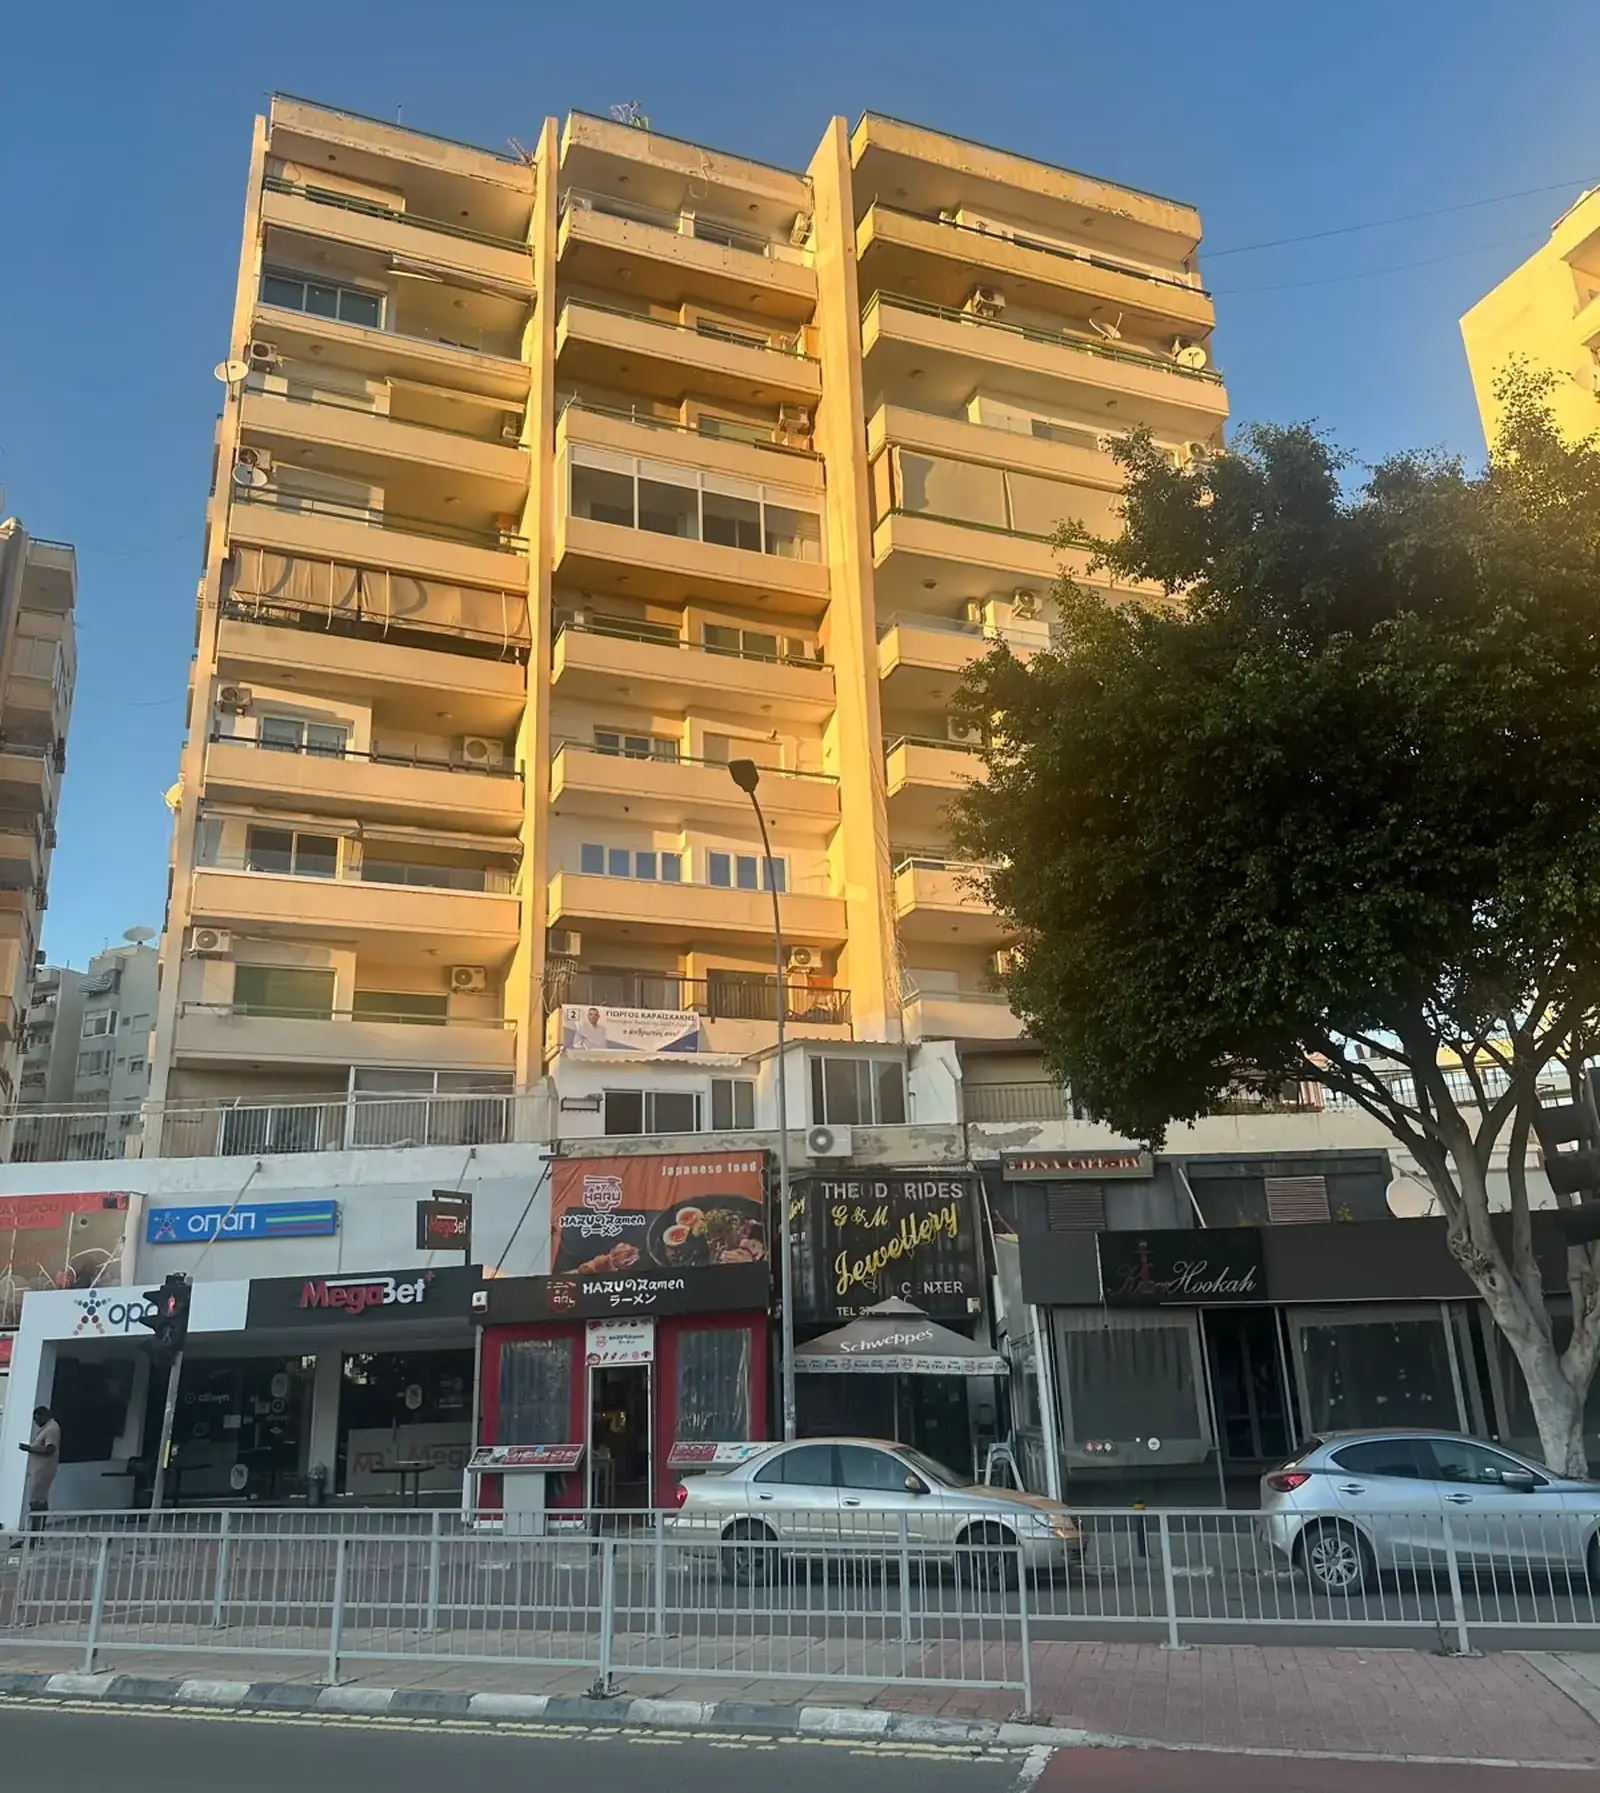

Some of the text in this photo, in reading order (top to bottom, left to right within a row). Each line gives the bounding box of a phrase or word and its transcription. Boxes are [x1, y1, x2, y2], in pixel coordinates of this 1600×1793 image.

[570, 1010, 577, 1019] 2
[606, 1010, 640, 1019] ΓΙΩΡΓΟΣ
[727, 1161, 757, 1173] food
[863, 1205, 889, 1228] M
[834, 1202, 959, 1296] Jewellery
[1167, 1260, 1257, 1295] Hookah
[609, 1293, 657, 1307] ラーメン
[836, 1306, 857, 1316] TEL
[839, 1328, 934, 1354] Schweppes
